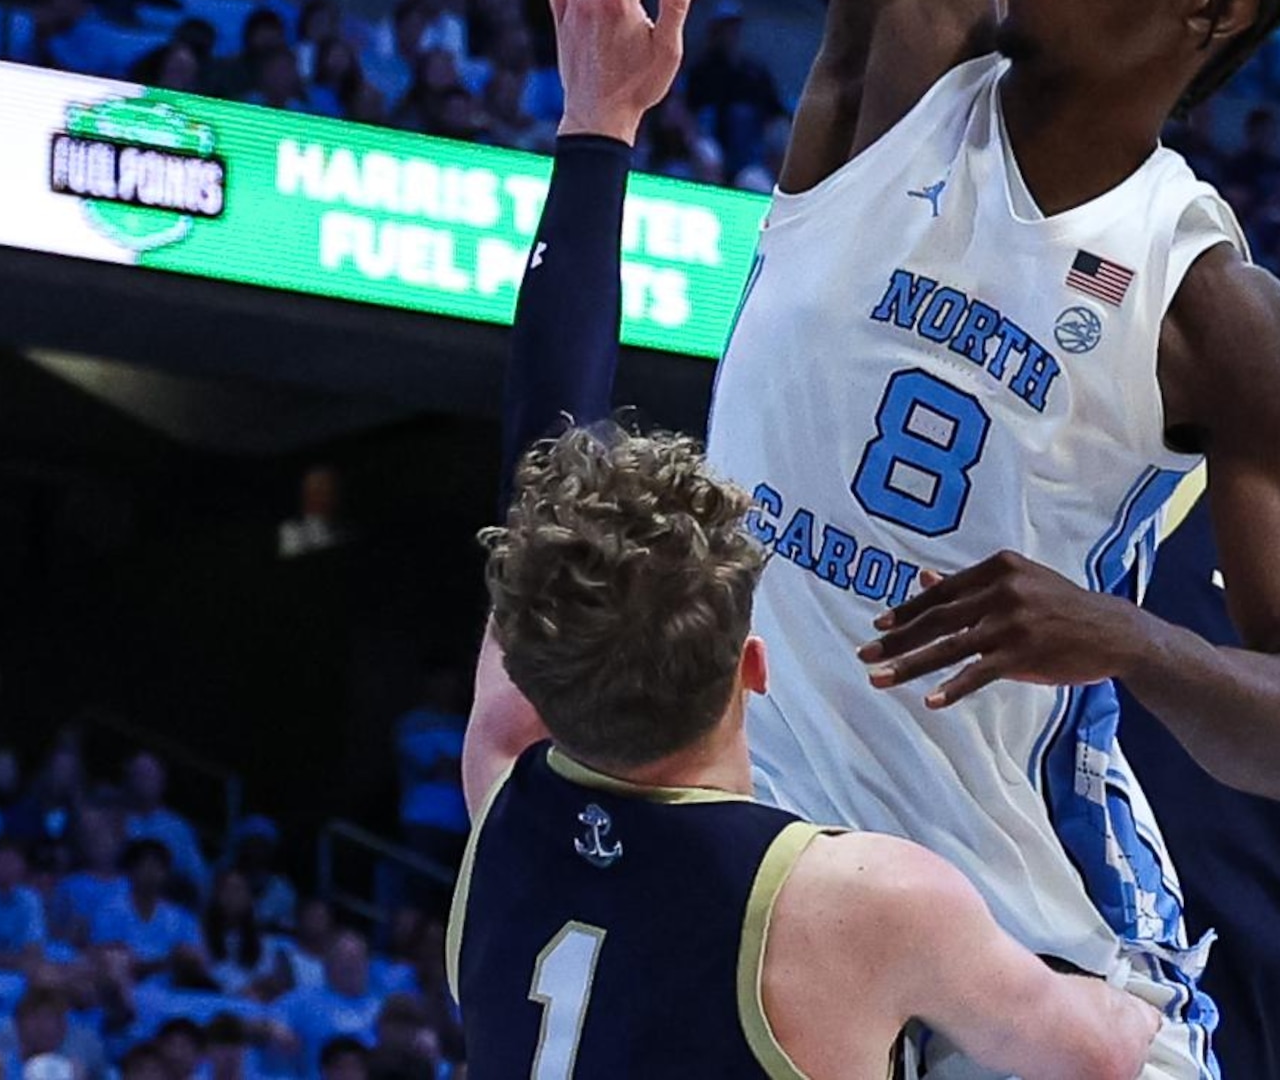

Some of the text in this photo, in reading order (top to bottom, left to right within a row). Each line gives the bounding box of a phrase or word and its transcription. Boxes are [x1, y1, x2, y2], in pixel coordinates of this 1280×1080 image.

[277, 138, 500, 228] HARRIS
[320, 209, 469, 292] FUEL
[870, 267, 1063, 415] NORTH
[850, 366, 992, 538] 8
[527, 920, 607, 1080] 1
